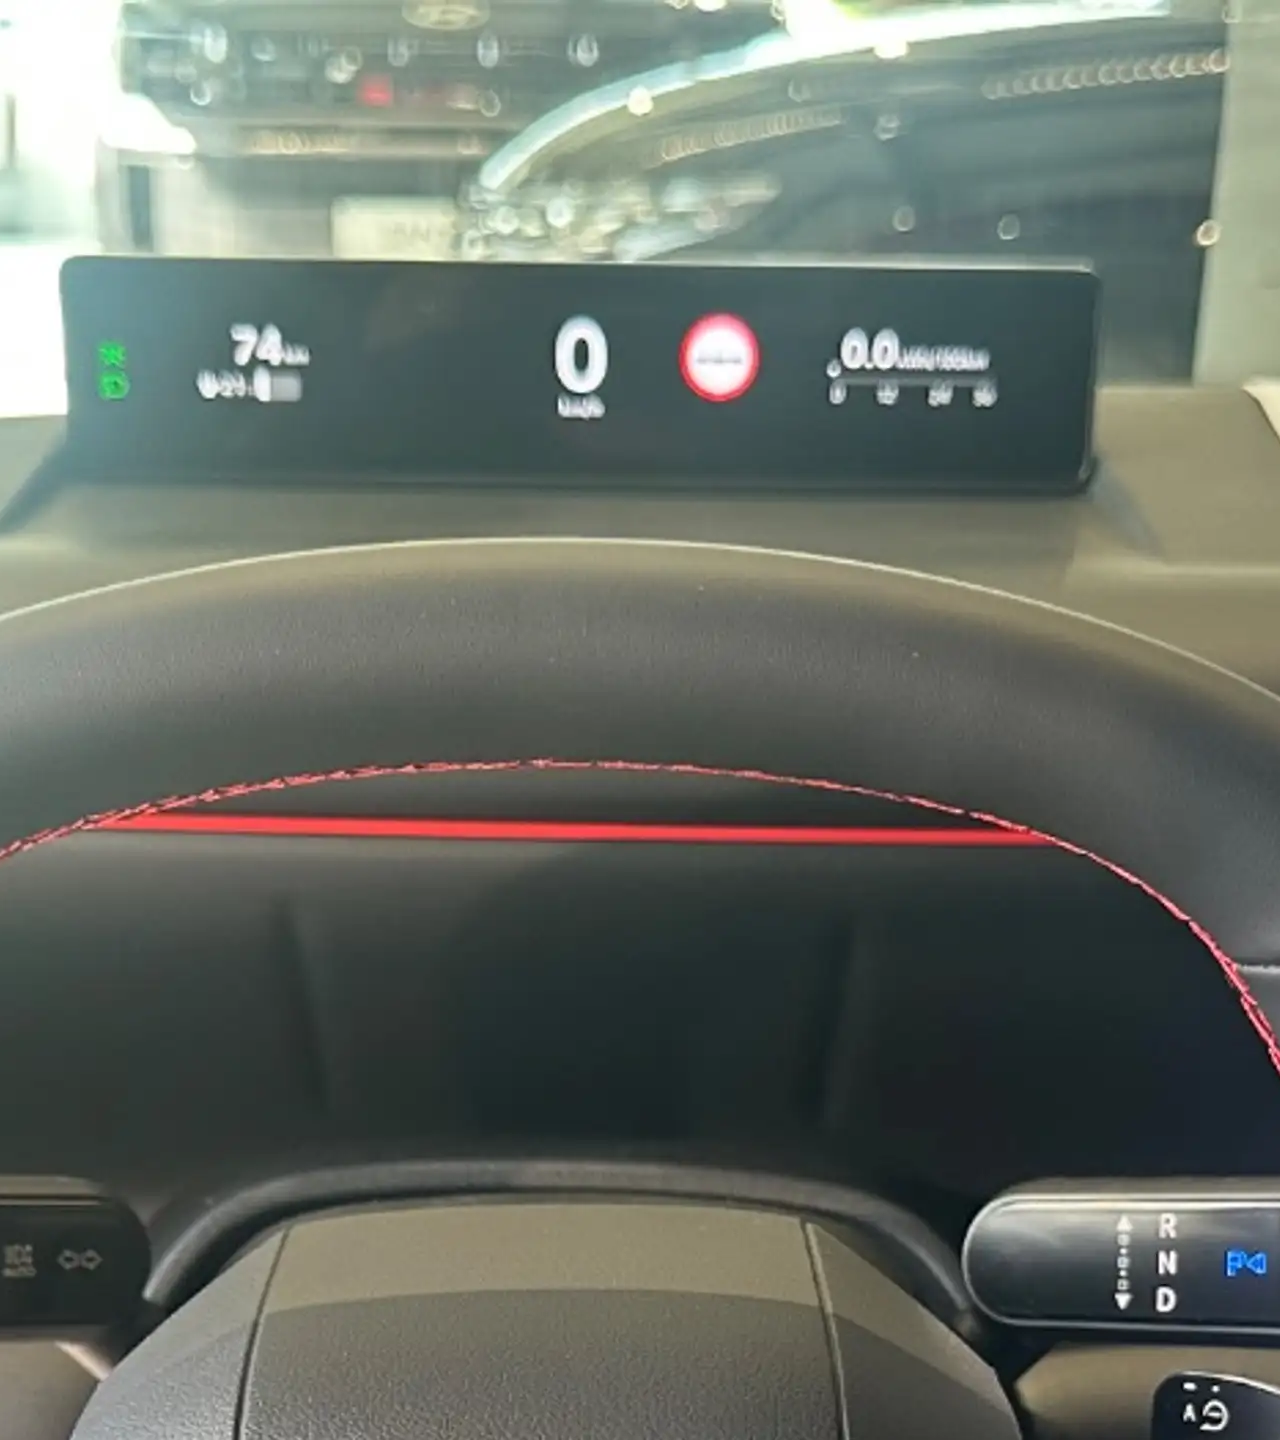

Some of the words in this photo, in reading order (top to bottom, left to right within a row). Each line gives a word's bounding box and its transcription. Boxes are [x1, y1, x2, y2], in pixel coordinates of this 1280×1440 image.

[555, 314, 608, 394] 0
[1158, 1212, 1178, 1239] R
[1157, 1250, 1178, 1275] N
[1155, 1286, 1177, 1313] D
